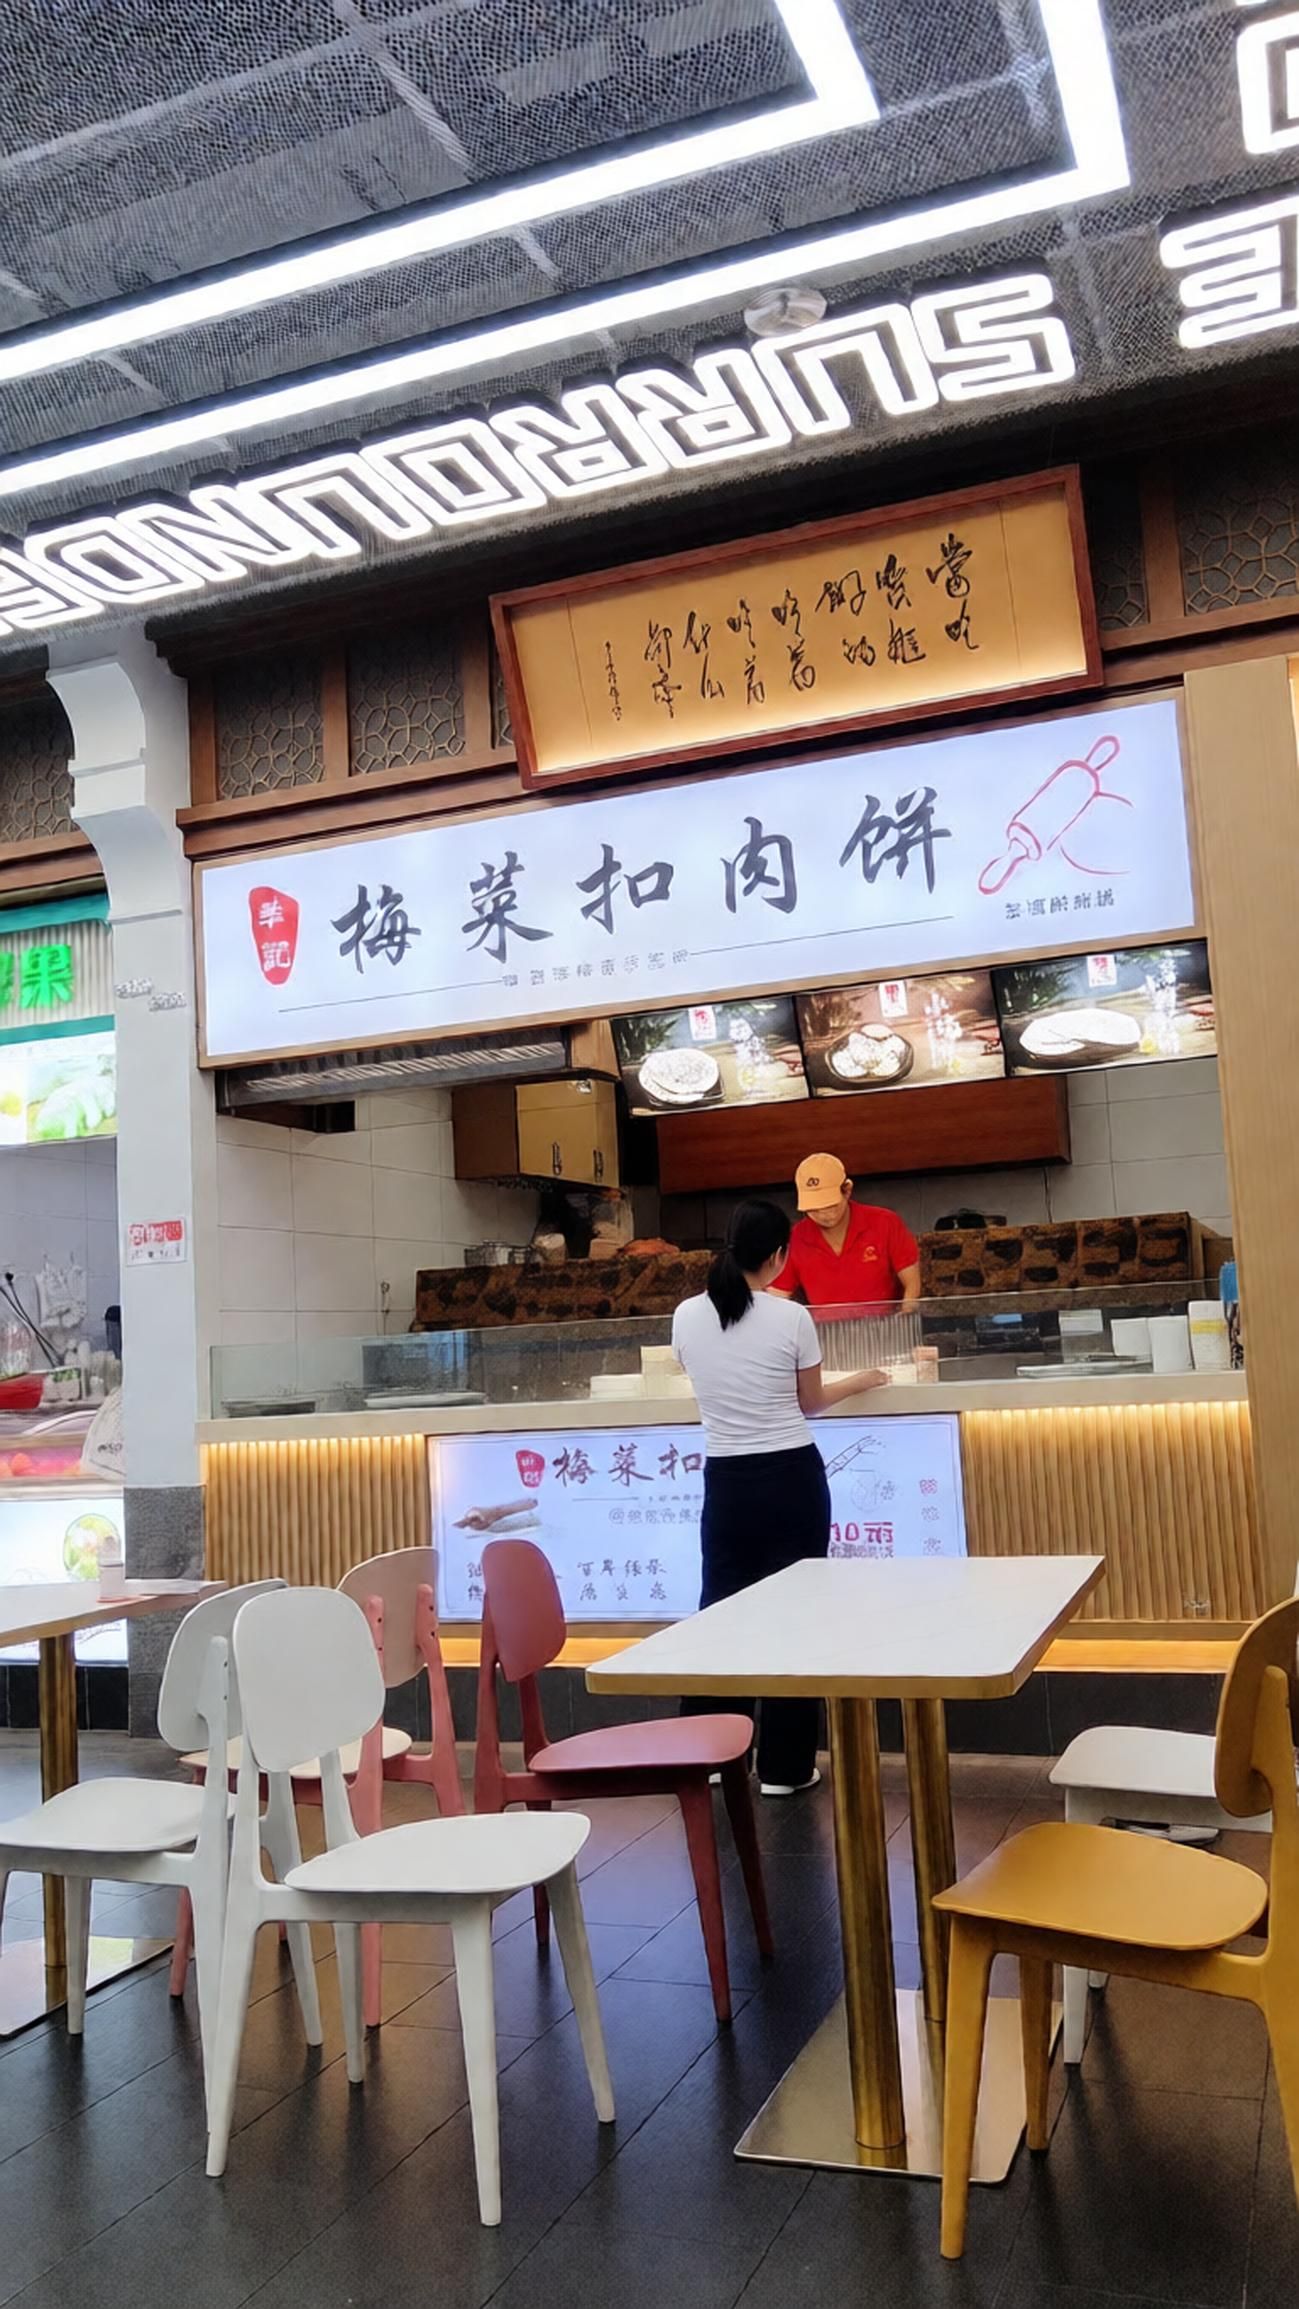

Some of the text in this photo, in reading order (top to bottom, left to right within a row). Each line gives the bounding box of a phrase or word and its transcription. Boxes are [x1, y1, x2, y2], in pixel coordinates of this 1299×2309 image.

[0, 272, 1076, 638] SURROUNDE
[330, 786, 952, 975] 梅菜扣肉饼
[552, 1442, 704, 1488] 梅菜扣
